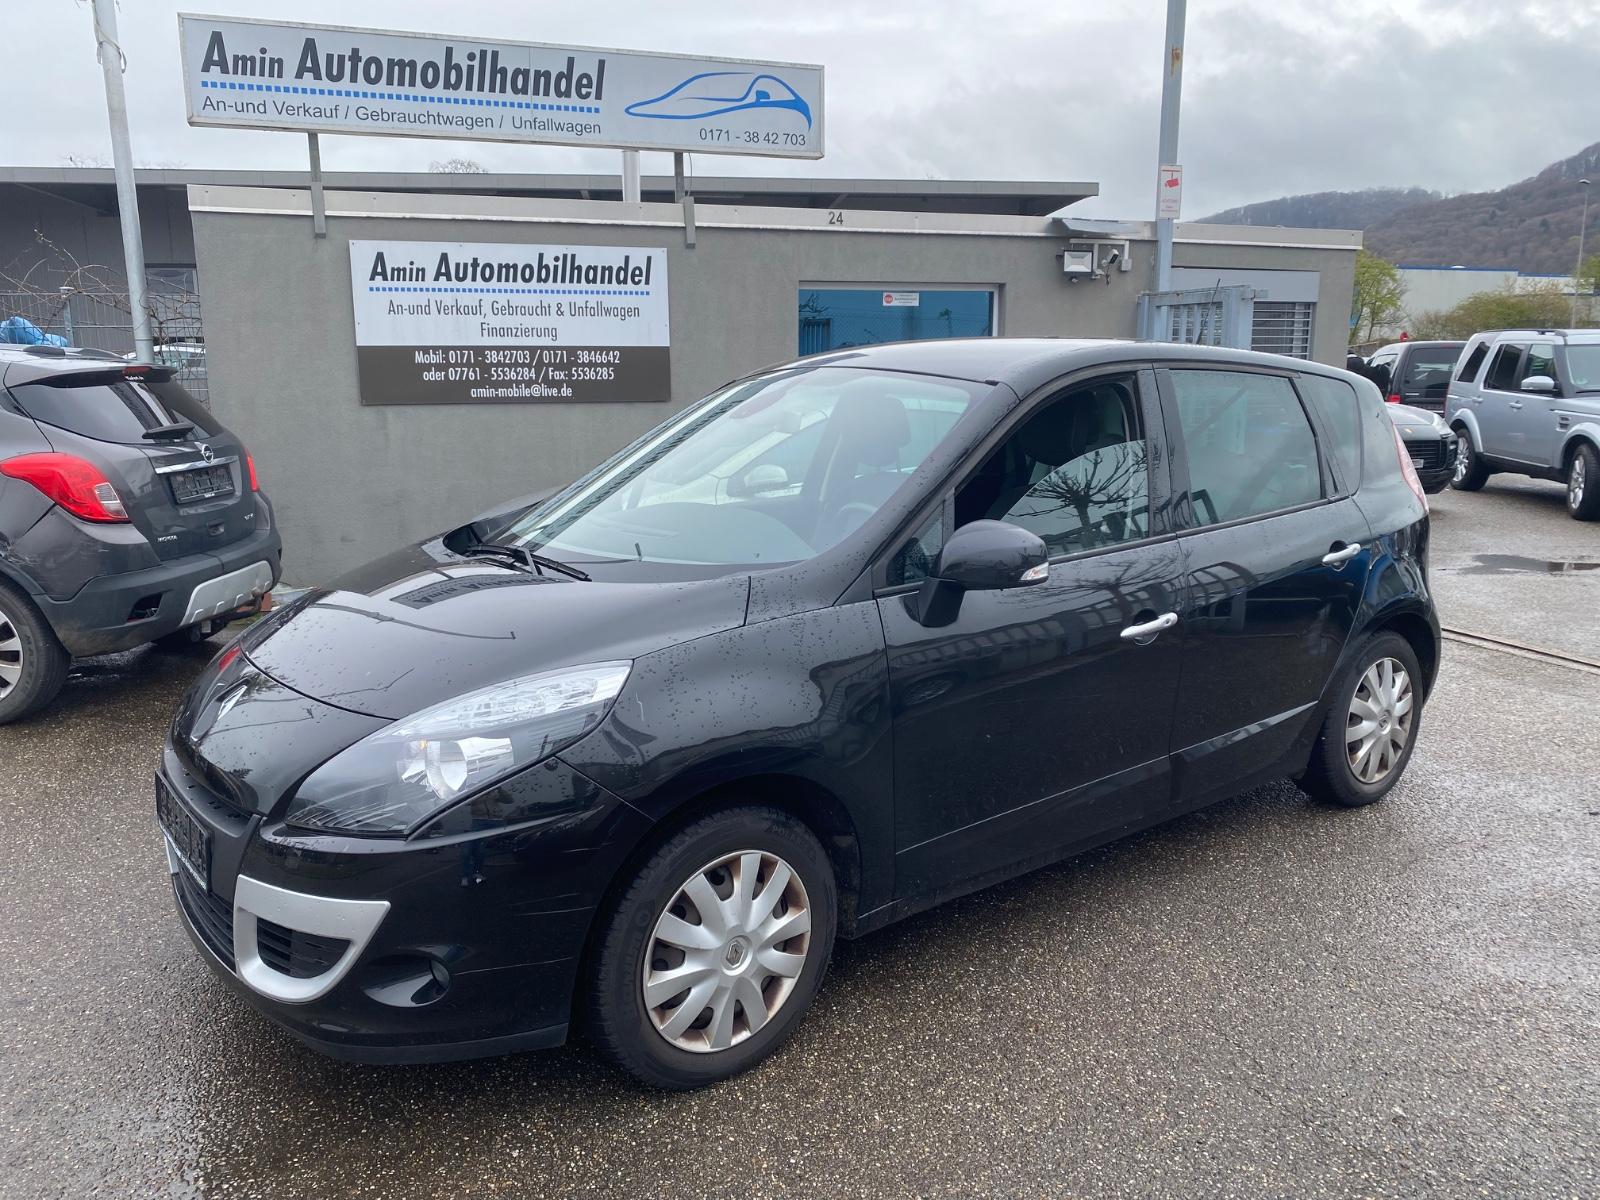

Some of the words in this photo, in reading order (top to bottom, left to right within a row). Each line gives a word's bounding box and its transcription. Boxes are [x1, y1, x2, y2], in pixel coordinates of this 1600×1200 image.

[201, 30, 284, 78] Amin
[294, 37, 606, 101] Automobilhandel
[202, 95, 267, 114] An-und
[273, 100, 340, 119] Verkauf
[344, 105, 350, 119] /
[355, 105, 494, 130] Gebrauchtwagen
[499, 114, 504, 129] /
[512, 116, 601, 136] Unfallwagen
[699, 128, 730, 142] 0171
[744, 130, 760, 144] 38
[763, 132, 779, 145] 42
[783, 133, 806, 146] 703
[828, 211, 844, 225] 24
[369, 251, 426, 282] Amin
[433, 252, 652, 286] Automobilhandel
[388, 298, 431, 315] An-und
[435, 298, 487, 318] Verkauf,
[491, 299, 551, 317] Gebraucht
[556, 302, 565, 317] &
[569, 300, 640, 321] Unfallwagen
[480, 321, 558, 342] Finanzierung
[415, 350, 446, 364] Mobil:
[449, 350, 474, 363] 0171
[485, 350, 530, 363] 3842703
[543, 350, 567, 363] 0171
[577, 350, 620, 363] 3846642
[423, 367, 445, 381] oder
[448, 367, 480, 381] 07761
[491, 367, 536, 380] 5536284
[549, 367, 569, 380] Fax:
[571, 367, 614, 380] 5536285
[470, 382, 573, 398] amin-mobile@live.de
